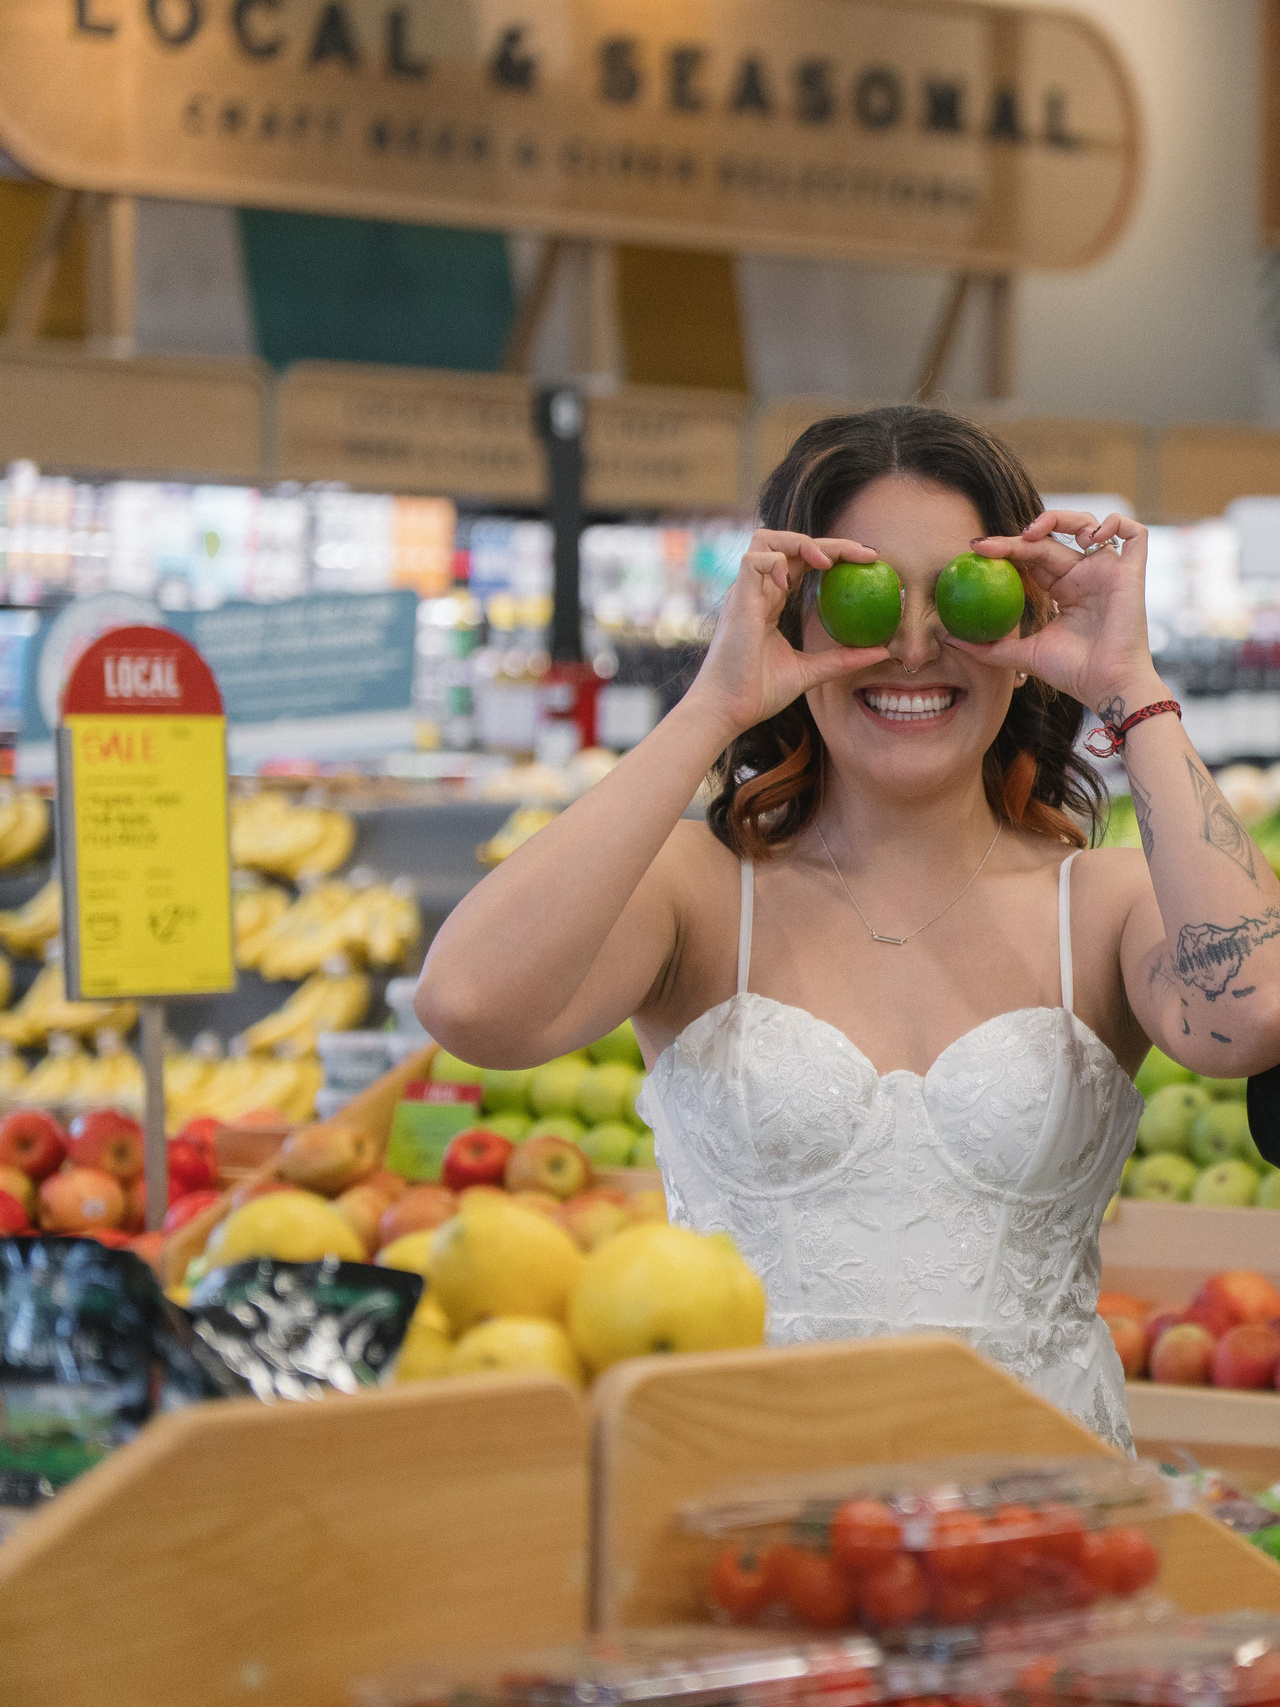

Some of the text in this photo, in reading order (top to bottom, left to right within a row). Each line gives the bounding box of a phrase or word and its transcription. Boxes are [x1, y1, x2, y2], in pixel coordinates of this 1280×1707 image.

[70, 0, 1080, 152] LOCAL & SEASONAL
[104, 655, 183, 699] LOCAL
[80, 728, 162, 766] SALE
